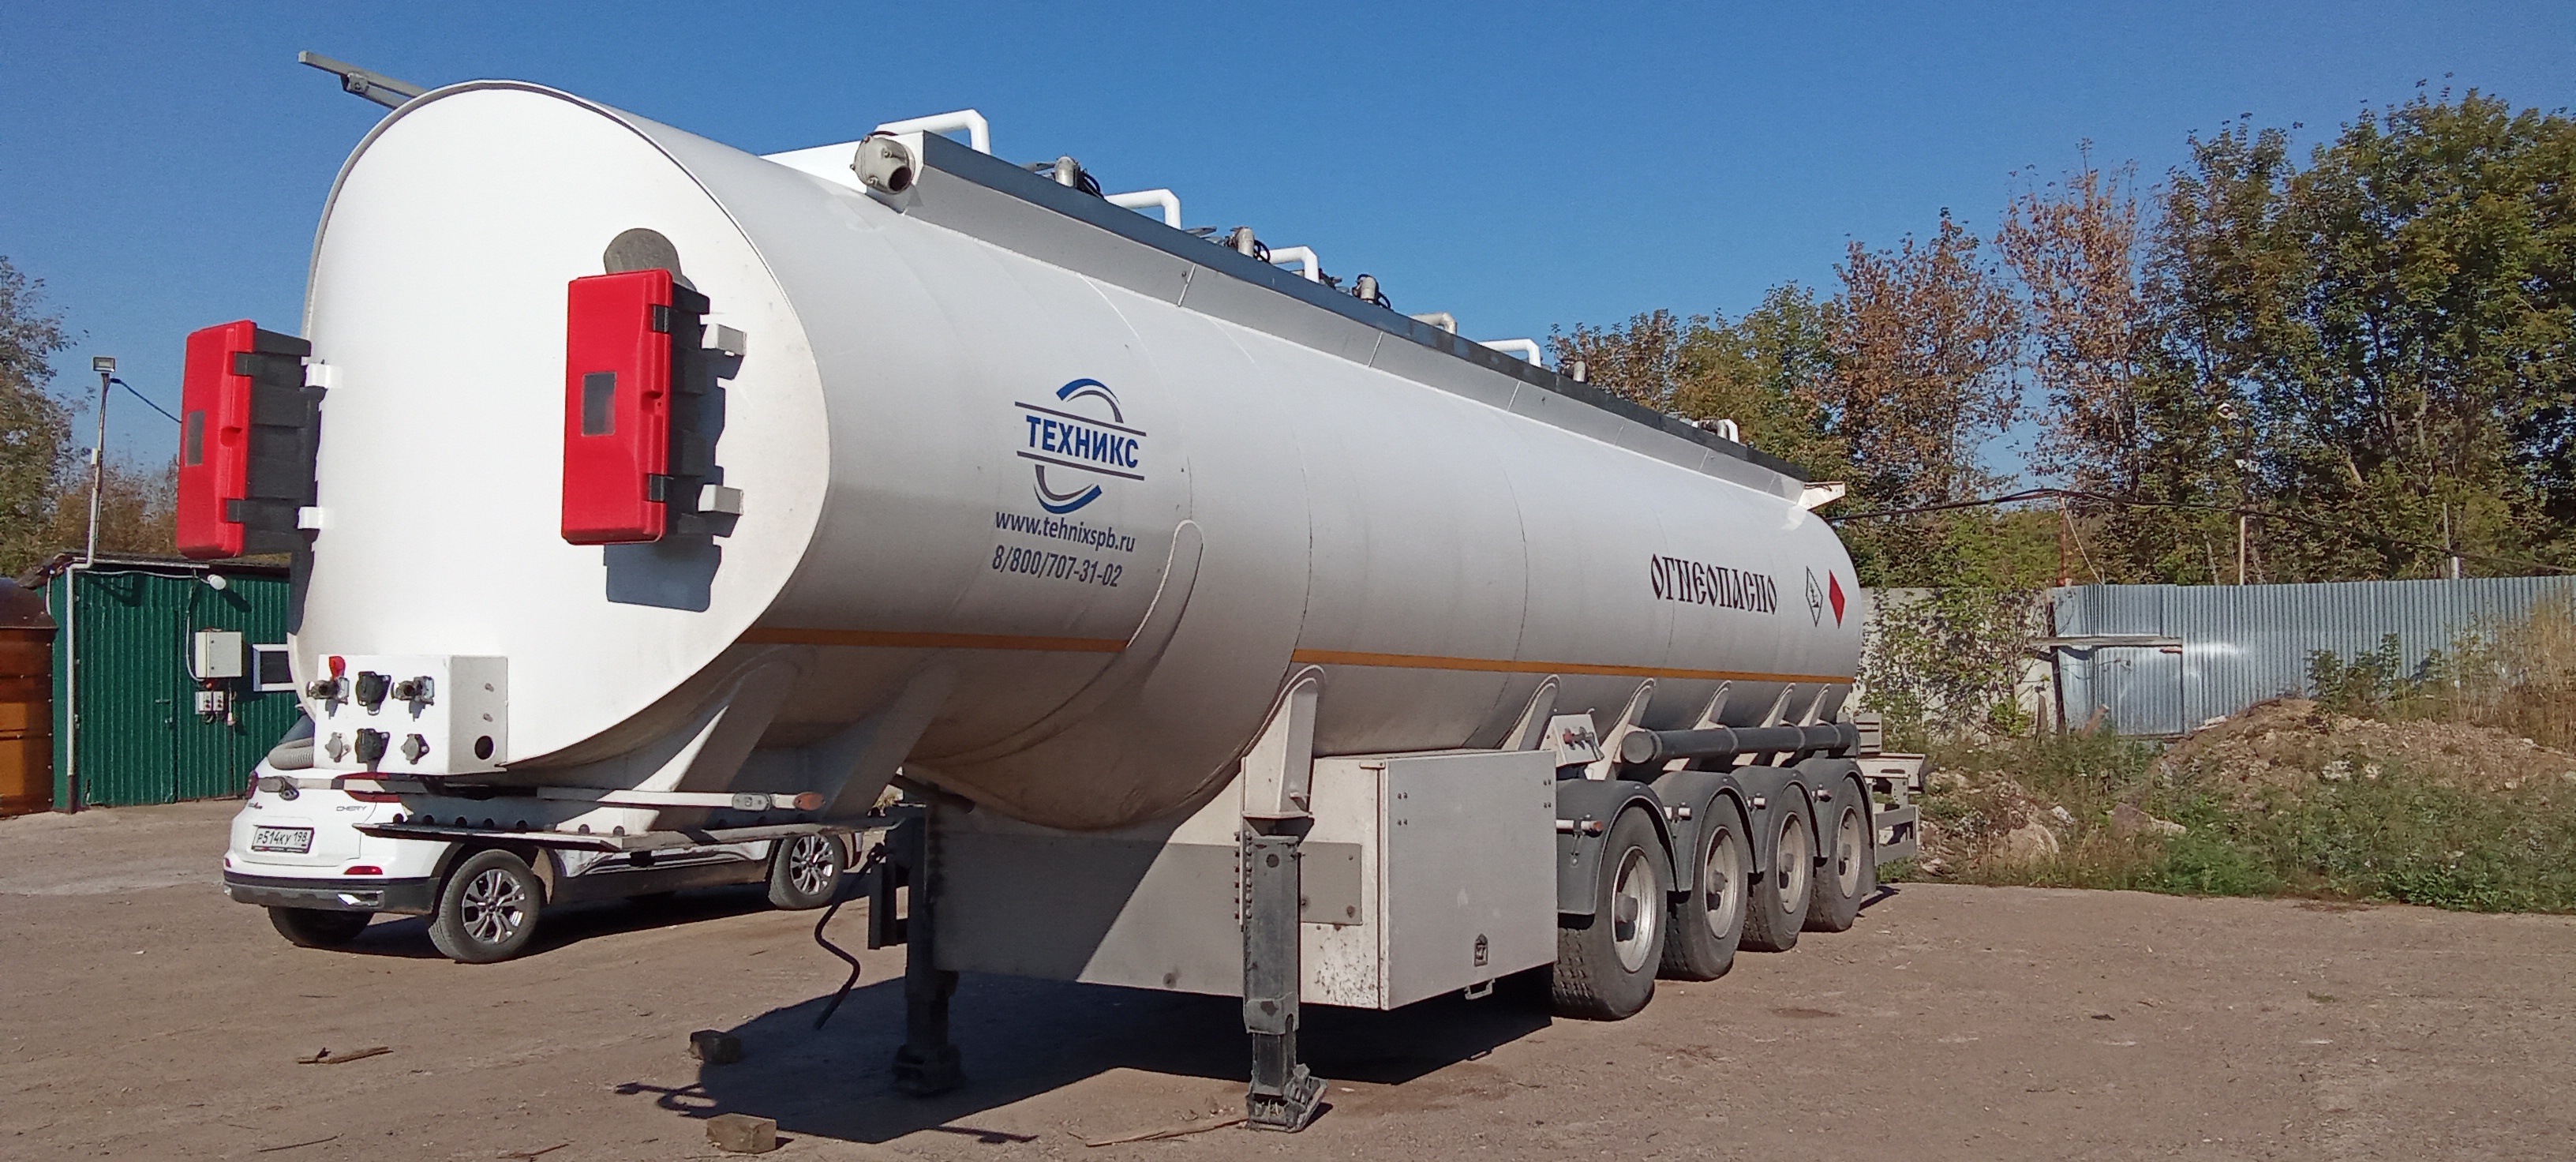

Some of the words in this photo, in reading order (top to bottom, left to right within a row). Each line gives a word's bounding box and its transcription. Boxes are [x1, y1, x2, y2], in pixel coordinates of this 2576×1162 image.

[1026, 414, 1139, 468] ТЕХНИКС
[995, 512, 1135, 553] www.tehnixspb.ru
[992, 545, 1122, 587] 8/800/707-31-02
